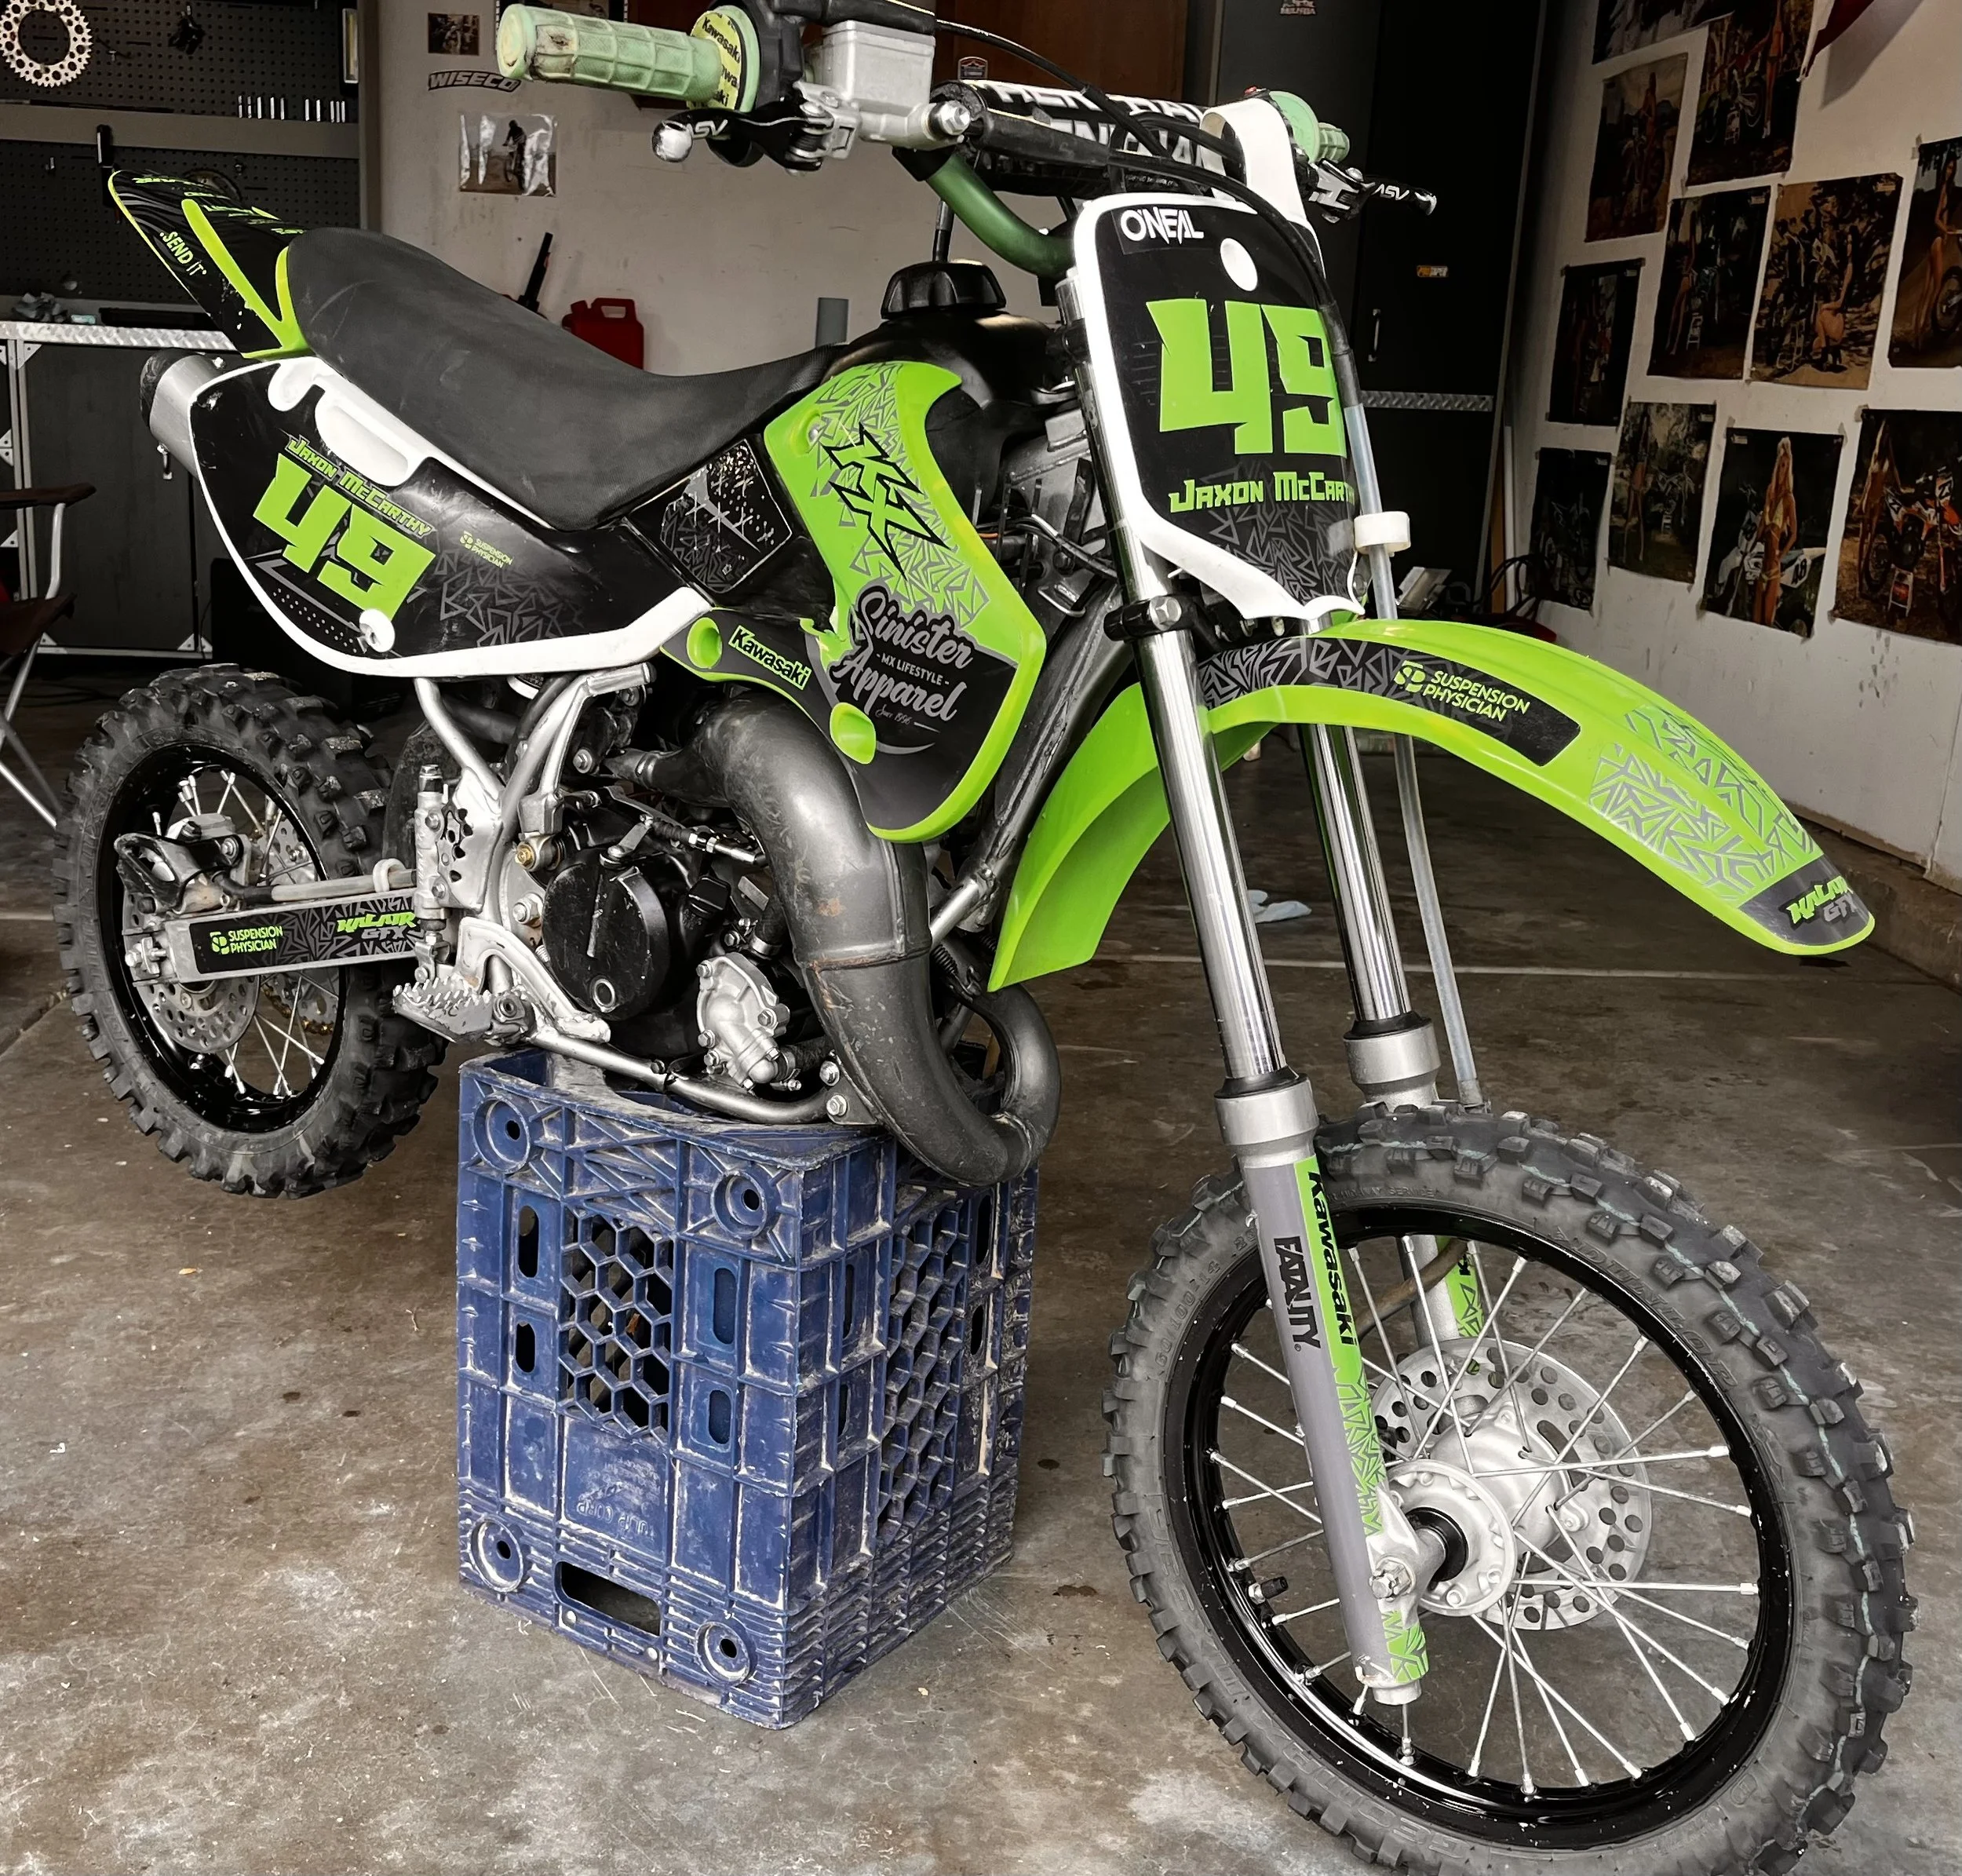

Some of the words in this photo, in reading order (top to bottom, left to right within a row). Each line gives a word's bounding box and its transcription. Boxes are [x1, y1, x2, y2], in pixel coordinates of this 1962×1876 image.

[429, 71, 520, 93] WISECO
[1121, 206, 1205, 244] O'NEAL
[161, 231, 195, 265] SEND
[186, 261, 204, 276] IT
[1147, 298, 1348, 458] 49
[252, 452, 436, 622] 49
[474, 538, 515, 565] SUSPENSION
[861, 591, 974, 670] Sinister
[729, 626, 811, 690] Kawasaki
[881, 652, 895, 668] MX
[896, 659, 944, 686] LIFESTYLE
[832, 647, 968, 722] Apparel
[1421, 681, 1509, 723] PHYSICIAN
[1428, 668, 1531, 716] SUSPENSION
[228, 925, 283, 943] SUSPENSION
[229, 937, 278, 954] PHYSICIAN
[361, 925, 409, 940] GFX
[1307, 1171, 1354, 1345] Kawasaki
[1273, 1235, 1322, 1349] FATALITY
[1578, 1240, 1739, 1390] DUNLOP
